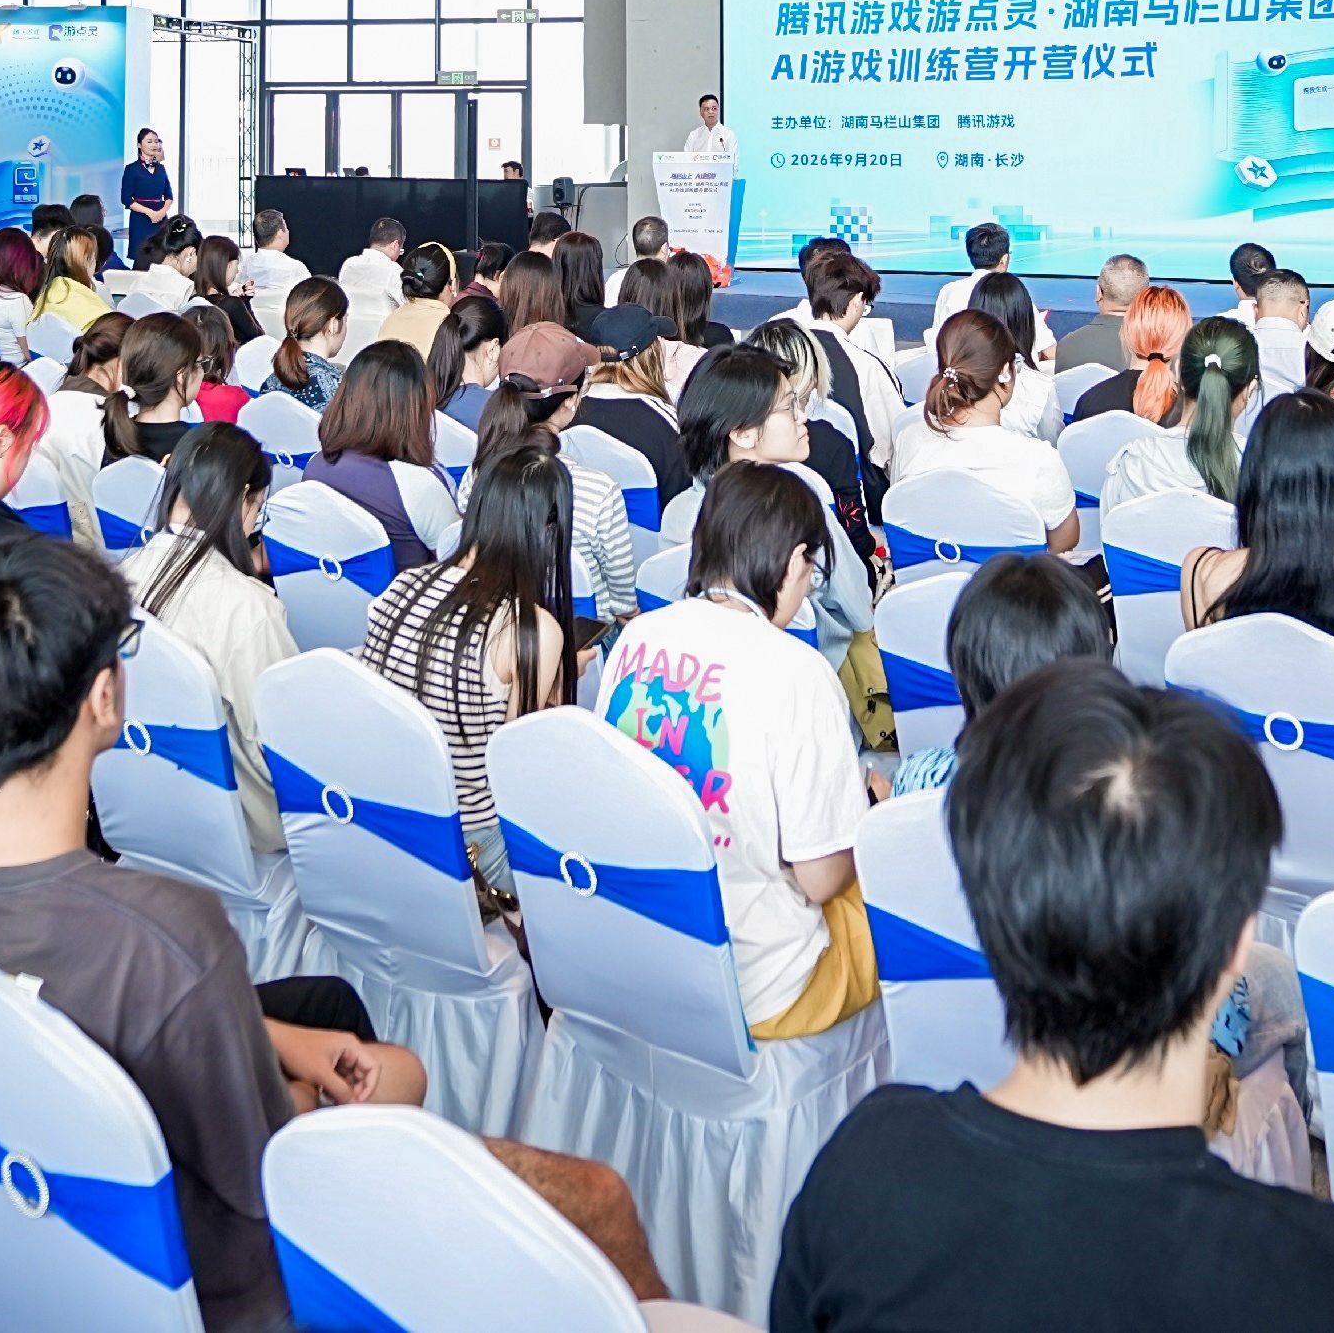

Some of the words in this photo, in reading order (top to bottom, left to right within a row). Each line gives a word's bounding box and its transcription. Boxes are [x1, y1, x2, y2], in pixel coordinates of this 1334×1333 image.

[770, 41, 1158, 83] AI游戏训练营开营仪式
[957, 114, 1015, 129] 腾讯游戏
[791, 152, 903, 168] 2026年9月20日
[614, 643, 726, 703] MADE
[634, 708, 689, 756] IN
